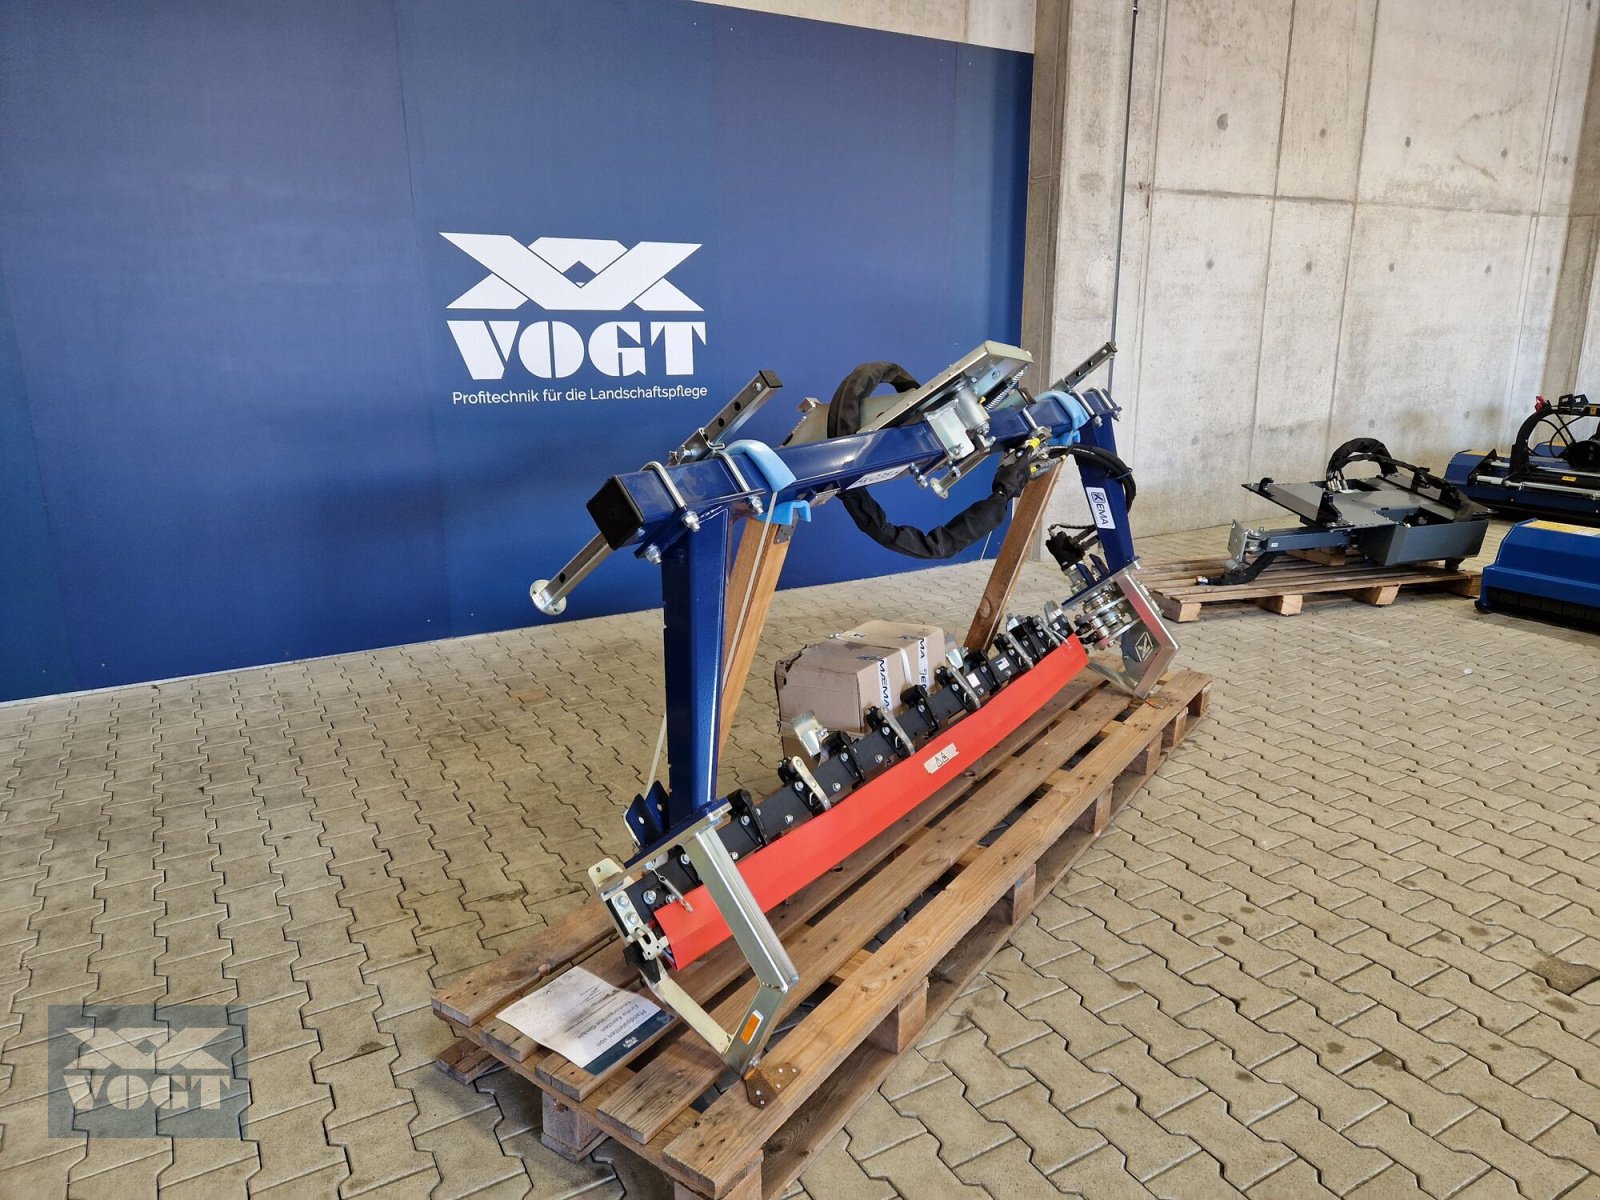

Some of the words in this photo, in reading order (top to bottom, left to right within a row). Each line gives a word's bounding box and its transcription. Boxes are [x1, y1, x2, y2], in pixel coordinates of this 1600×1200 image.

[447, 320, 707, 380] VOGT
[453, 389, 539, 405] Profitechnik
[543, 388, 562, 402] für
[565, 387, 587, 401] die
[590, 385, 708, 400] Landschaftspflege
[1091, 491, 1109, 525] KEMA
